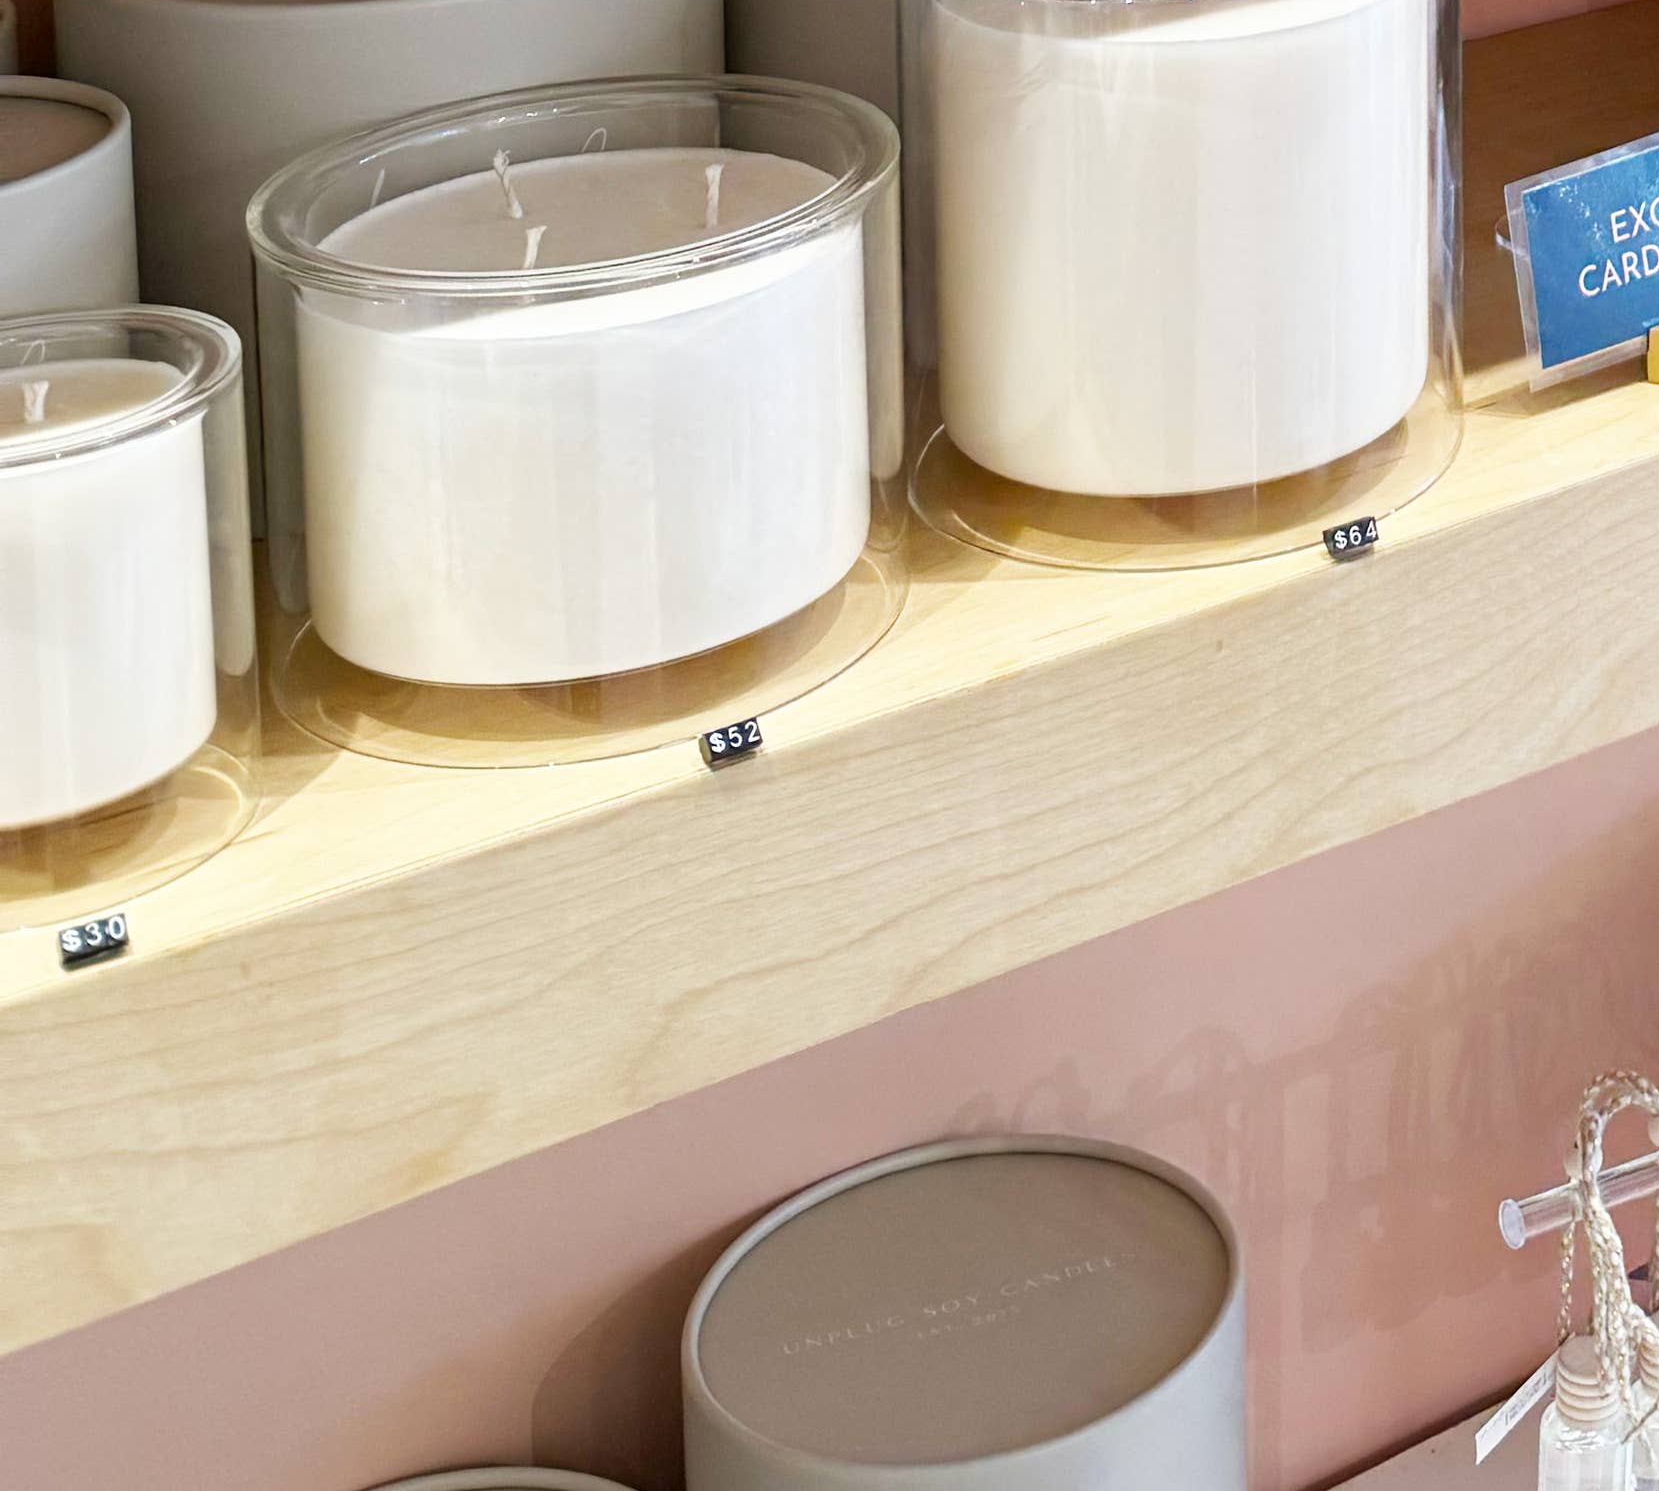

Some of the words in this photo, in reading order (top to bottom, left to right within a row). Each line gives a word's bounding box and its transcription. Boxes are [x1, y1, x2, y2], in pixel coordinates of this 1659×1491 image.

[1334, 519, 1377, 549] $64
[709, 720, 760, 754] $52
[61, 915, 126, 953] $30
[783, 1316, 906, 1356] UNPLUG
[922, 1290, 980, 1317] SOY
